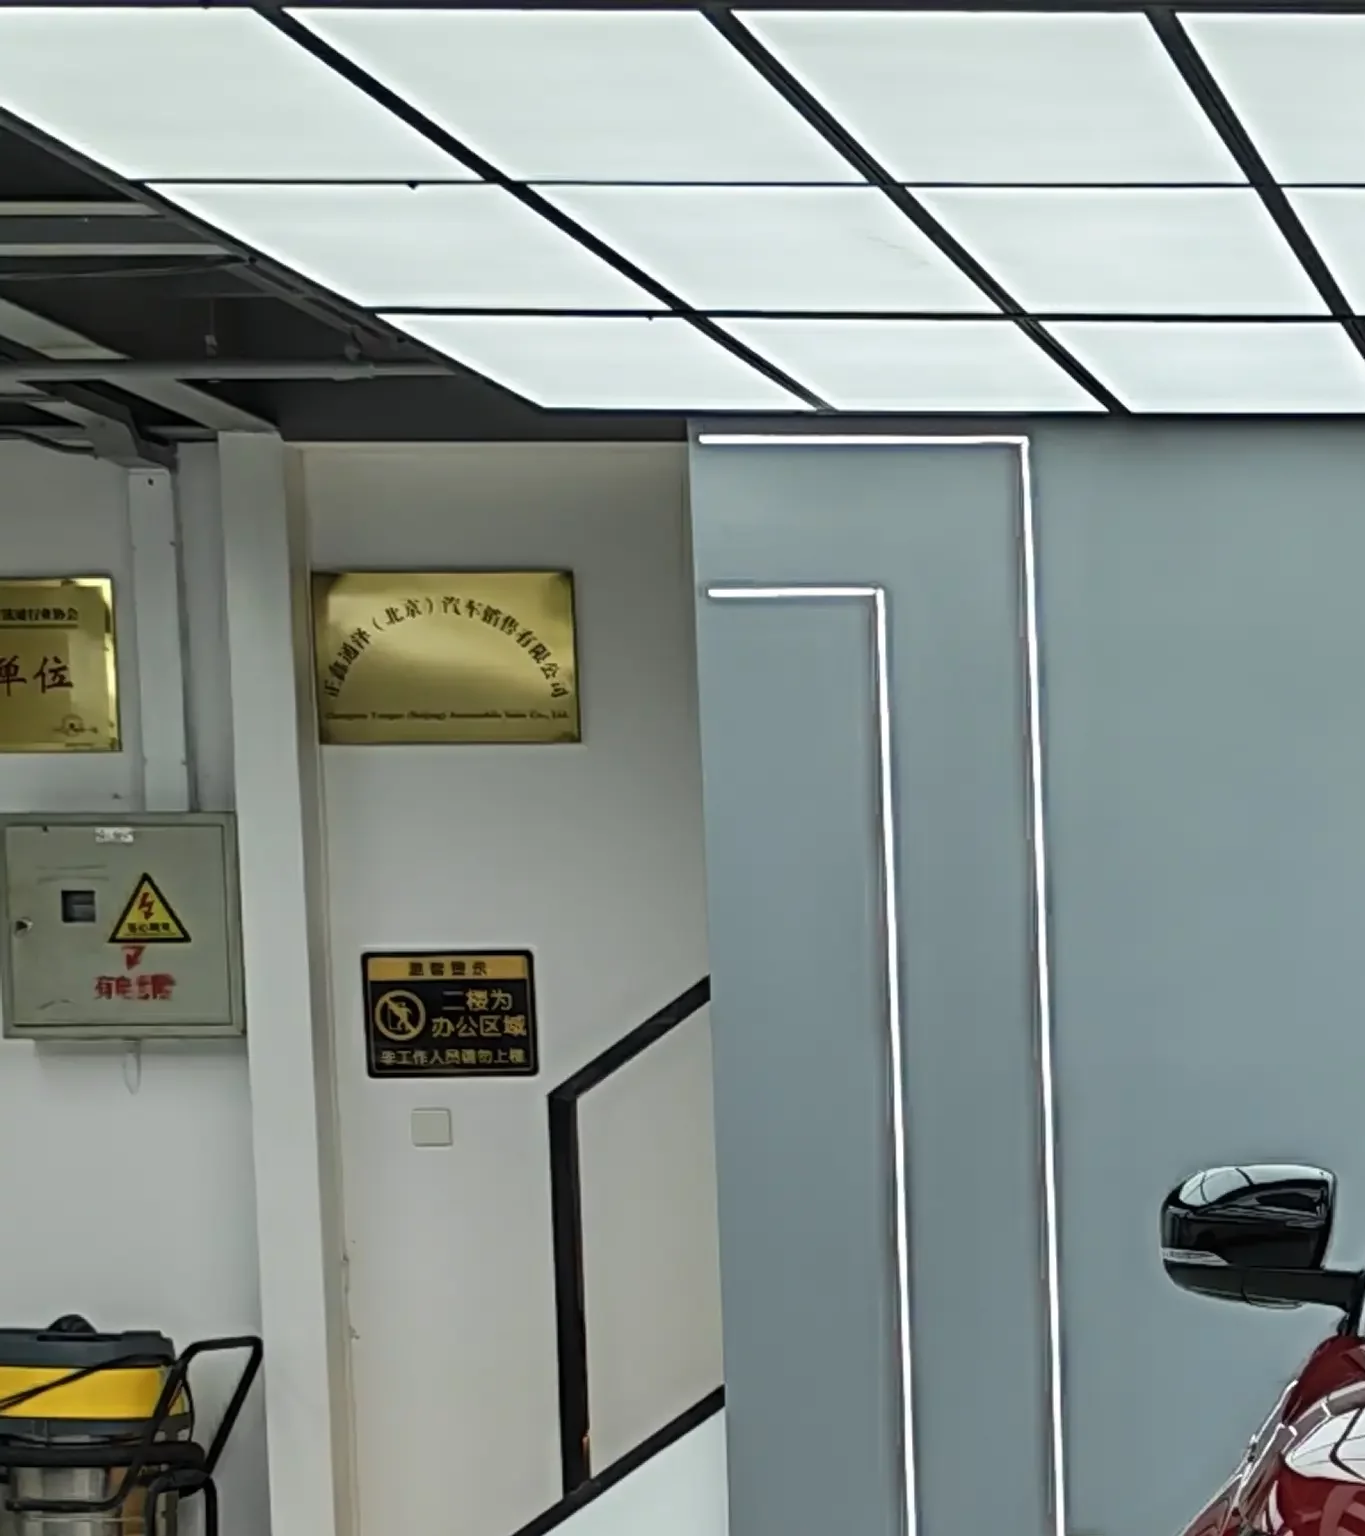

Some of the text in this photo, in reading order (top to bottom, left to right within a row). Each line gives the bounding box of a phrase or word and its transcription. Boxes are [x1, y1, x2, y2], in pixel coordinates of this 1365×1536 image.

[441, 988, 513, 1012] 二楼为
[431, 1014, 527, 1038] 办公区域
